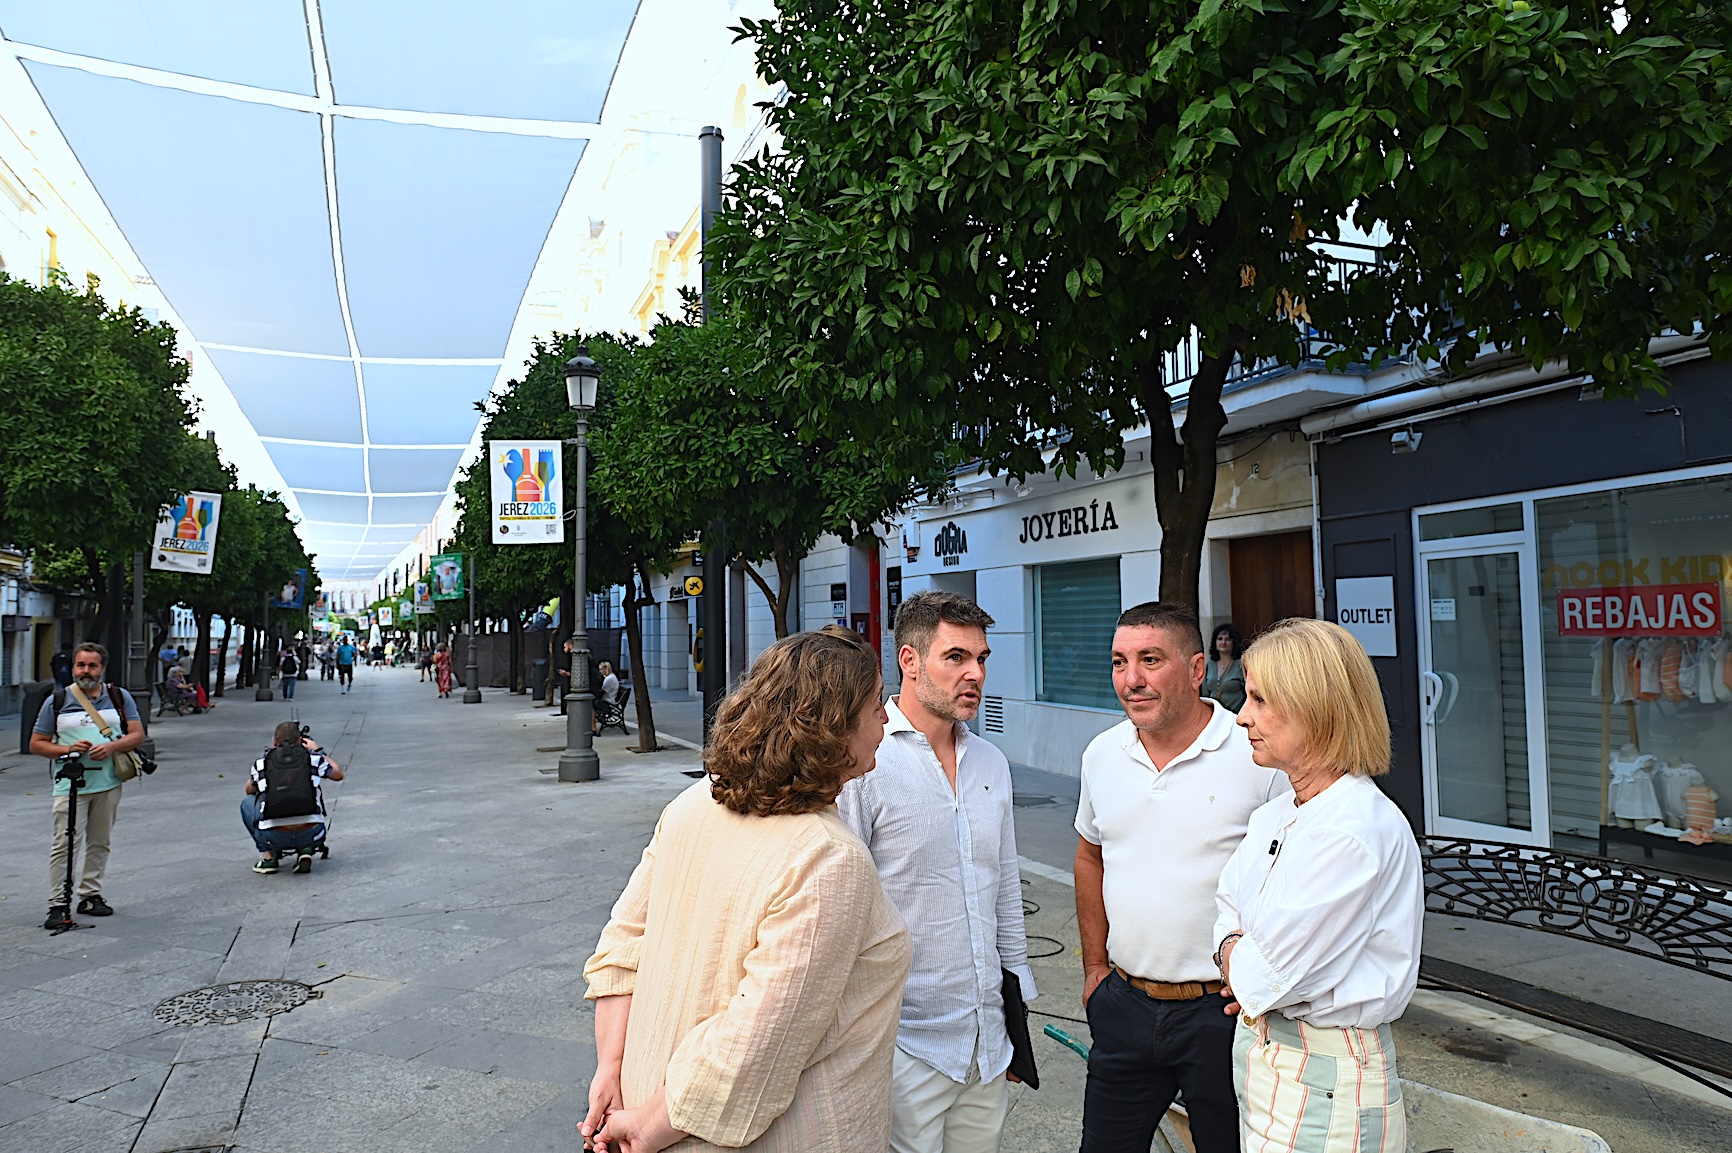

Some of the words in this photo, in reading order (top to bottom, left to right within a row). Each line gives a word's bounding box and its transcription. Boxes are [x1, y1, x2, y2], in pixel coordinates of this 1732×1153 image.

[1250, 463, 1259, 474] 12
[1019, 498, 1119, 544] JOYERÍA
[1340, 608, 1393, 624] OUTLET
[1563, 592, 1716, 629] REBAJAS
